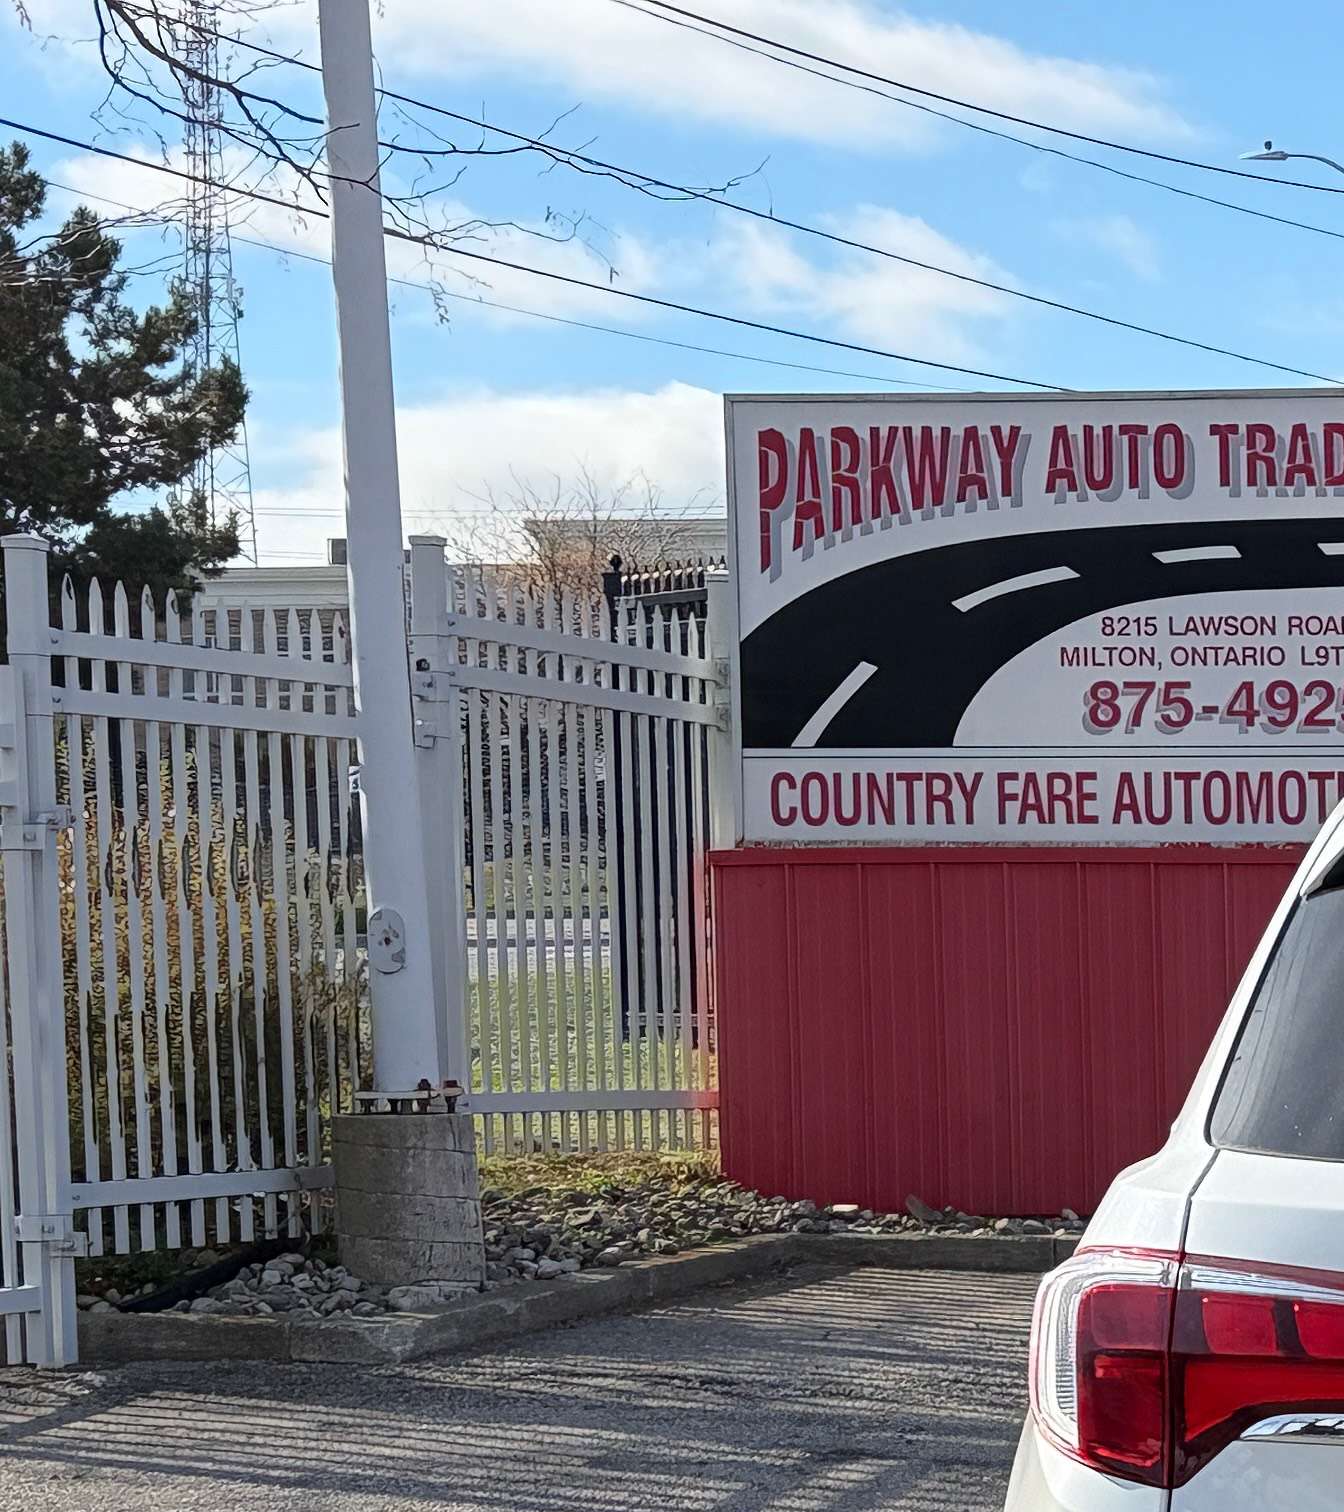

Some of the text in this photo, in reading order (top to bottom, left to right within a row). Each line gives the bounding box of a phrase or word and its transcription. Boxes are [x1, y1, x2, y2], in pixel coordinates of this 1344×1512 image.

[757, 424, 1024, 576] PARKWAY
[1045, 422, 1186, 494] AUTO
[1101, 616, 1158, 636] 8215
[1169, 615, 1276, 637] LAWSON
[1060, 646, 1163, 670] MILTON,
[1170, 645, 1286, 668] ONTARIO
[1300, 646, 1344, 667] L9T
[770, 771, 984, 827] COUNTRY
[997, 771, 1100, 825] FARE
